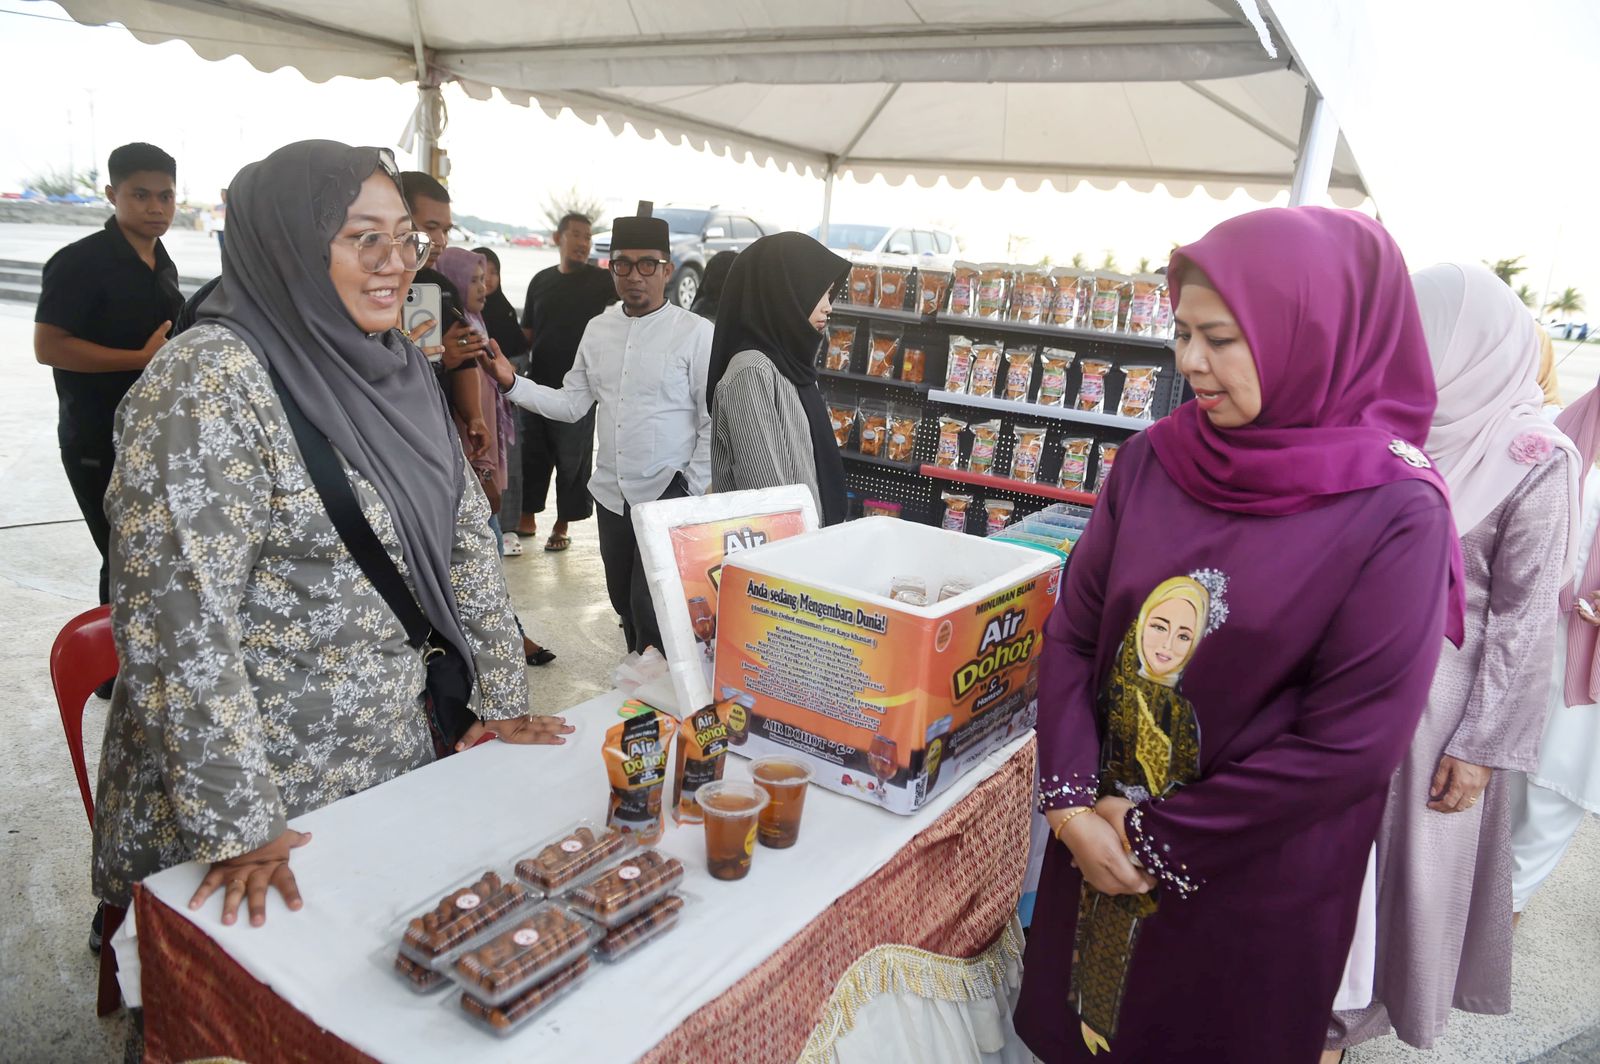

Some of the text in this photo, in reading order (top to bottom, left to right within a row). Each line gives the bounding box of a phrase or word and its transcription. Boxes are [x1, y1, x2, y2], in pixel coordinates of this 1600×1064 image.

[726, 530, 763, 554] Air
[747, 579, 885, 631] Anda sedang Mengembara Dunia!
[976, 592, 1016, 615] MINUMAN
[766, 630, 782, 640] yang
[782, 634, 806, 645] dikenal
[807, 642, 831, 654] dengan
[980, 612, 1023, 652] Air
[745, 643, 768, 654] Berasal
[784, 655, 803, 665] Afrika
[804, 661, 822, 671] Utara
[824, 668, 839, 678] yang
[758, 641, 778, 650] Kurma
[826, 662, 849, 672] Kurma
[767, 636, 788, 647] Kurma
[813, 651, 835, 661] Kurma
[768, 664, 786, 673] dalam
[957, 634, 1033, 695] Dohot
[814, 672, 832, 683] tinggi
[698, 714, 713, 730] Air
[763, 719, 783, 735] AIR
[784, 724, 828, 749] DOHOT
[696, 723, 728, 746] Dohot
[630, 740, 656, 758] Air
